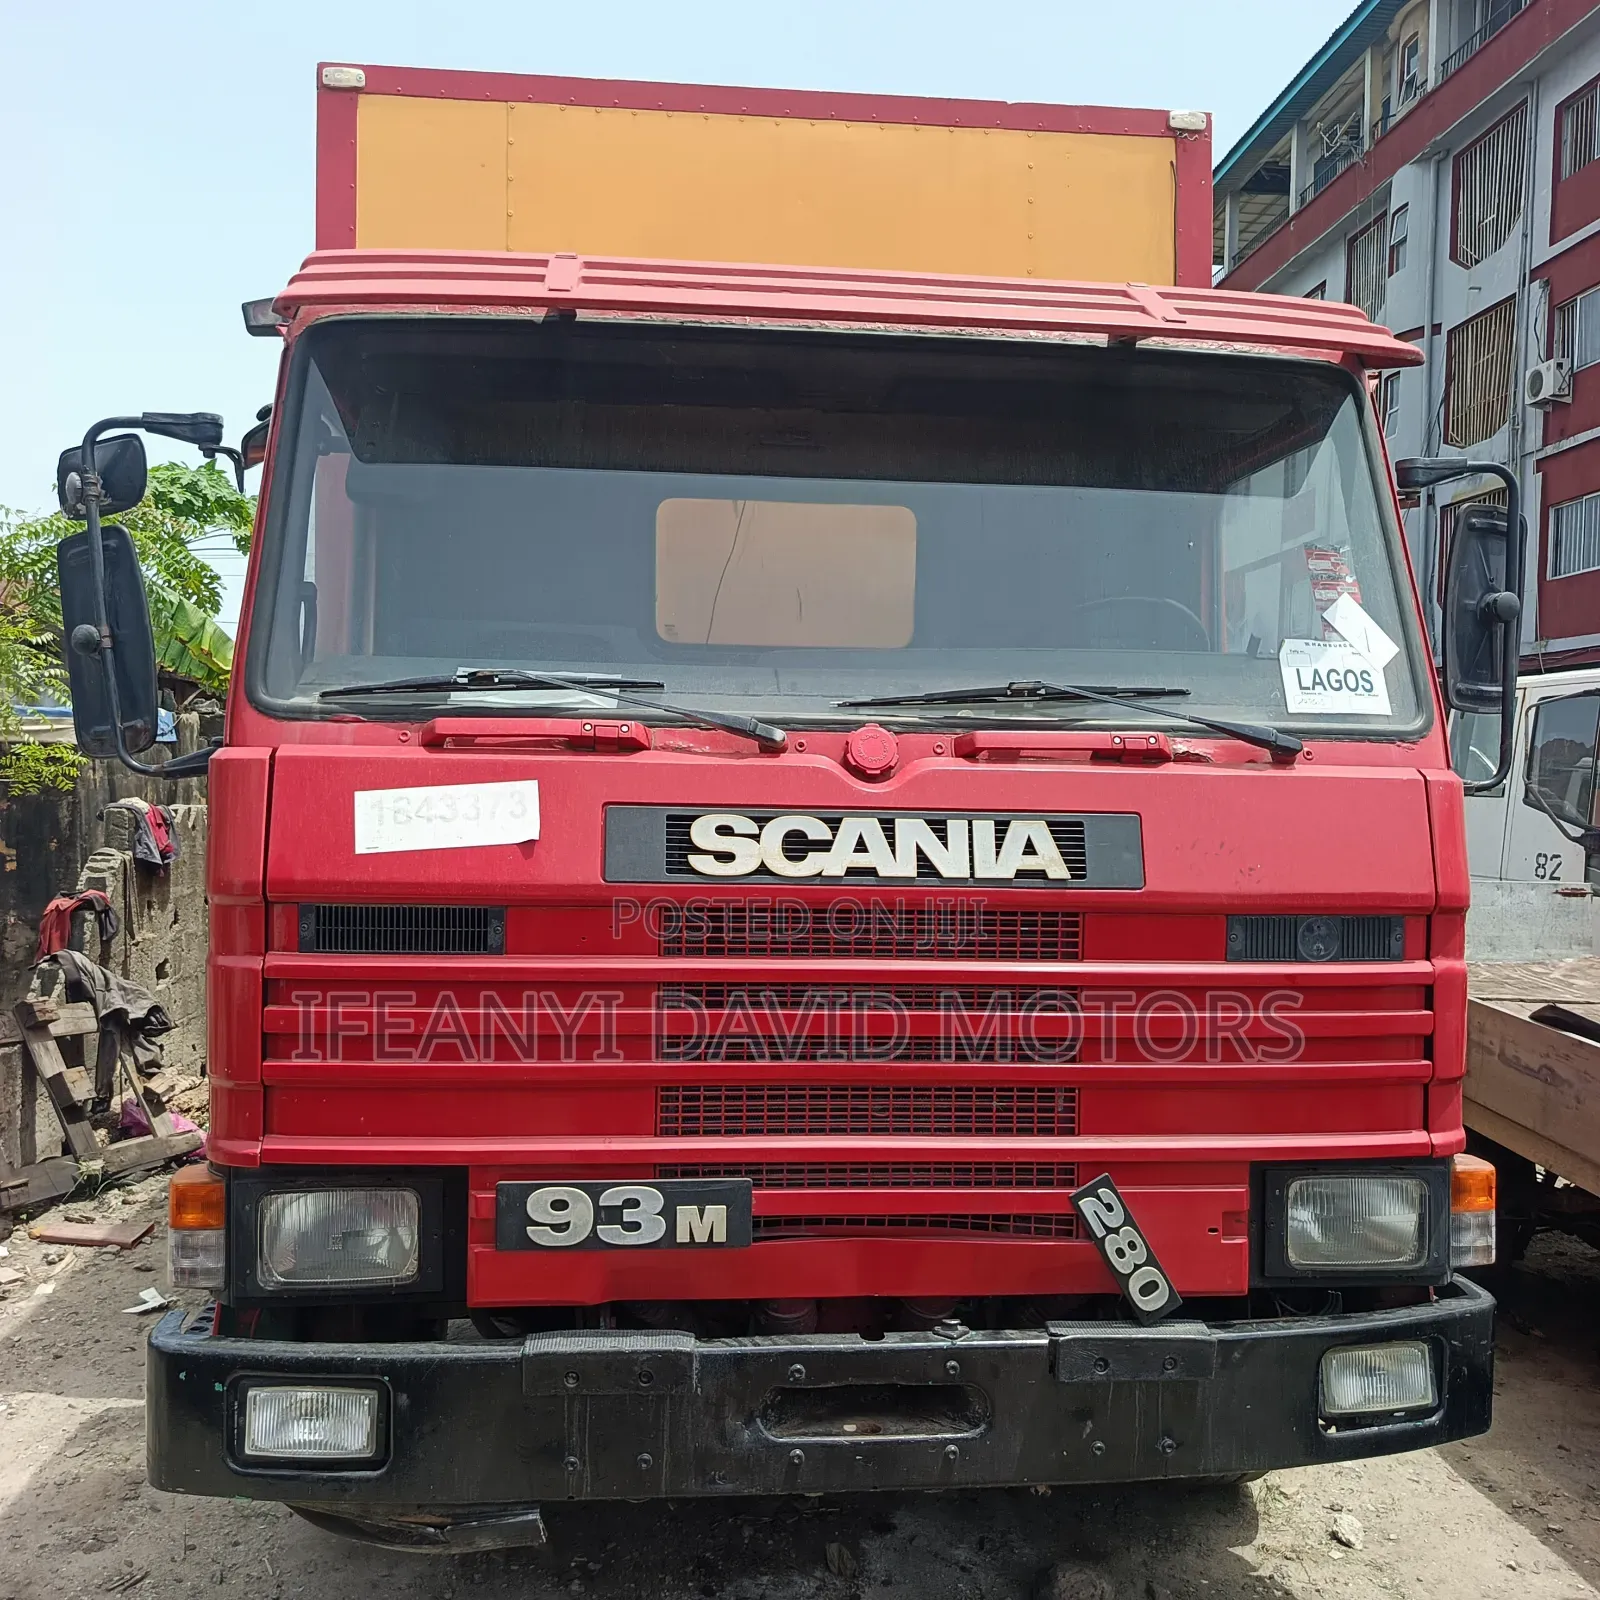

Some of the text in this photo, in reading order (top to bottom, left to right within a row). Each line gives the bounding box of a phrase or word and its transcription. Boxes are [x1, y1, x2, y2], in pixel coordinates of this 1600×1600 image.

[1295, 667, 1374, 693] LAGOS
[686, 813, 1073, 880] SCANIA
[1534, 852, 1563, 881] 82
[1077, 1187, 1170, 1312] 280
